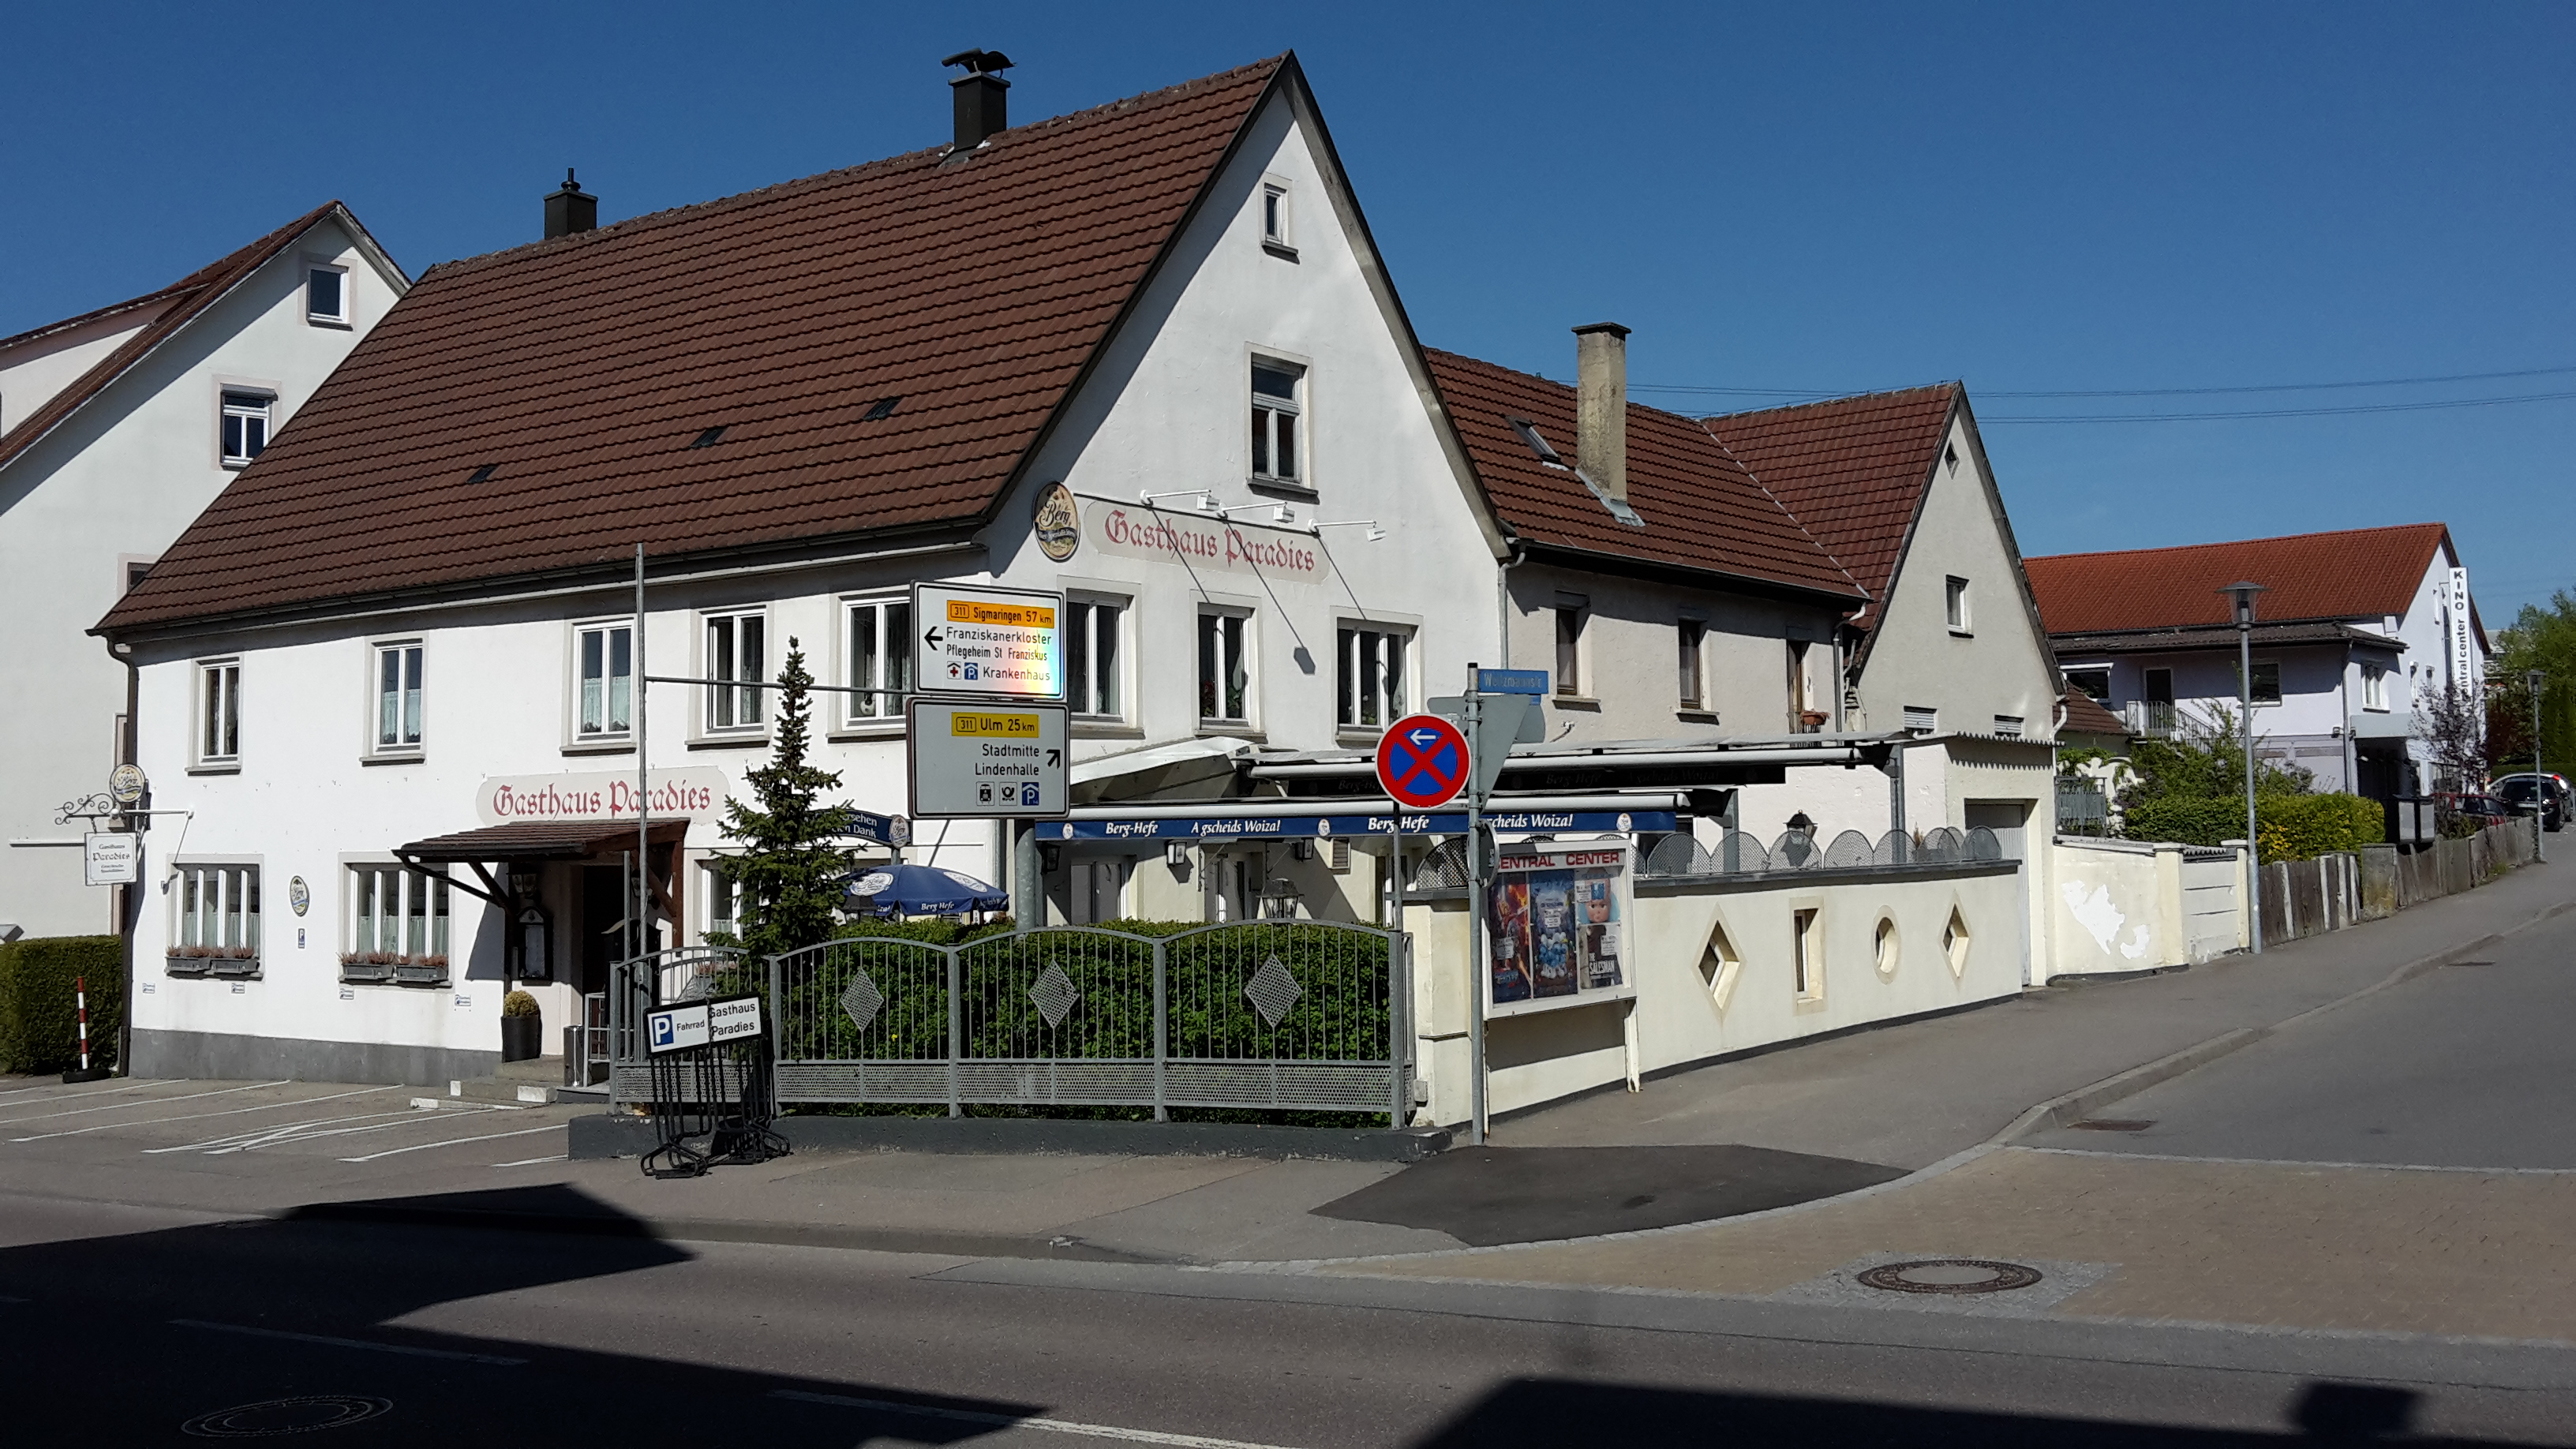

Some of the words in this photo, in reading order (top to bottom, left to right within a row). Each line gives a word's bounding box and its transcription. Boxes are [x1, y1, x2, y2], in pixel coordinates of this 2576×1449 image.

[1039, 500, 1070, 526] Berg
[1105, 510, 1218, 559] Gasthaus
[1224, 528, 1314, 571] Paradies
[2454, 571, 2464, 610] KINO
[954, 606, 965, 616] 311
[973, 607, 1021, 623] Sigmaringen
[1026, 611, 1037, 623] 57
[1040, 614, 1051, 623] km
[946, 627, 1051, 645] Franziskanerkloster
[2456, 620, 2467, 657] center
[947, 644, 990, 660] Pflegeheim
[994, 647, 1002, 658] St
[1009, 648, 1047, 661] Franziskus
[983, 666, 1050, 681] Krankenhaus
[960, 720, 972, 730] 311
[980, 717, 1002, 731] Ulm
[1008, 718, 1020, 732] 25
[1022, 722, 1035, 732] km
[982, 743, 1039, 757] Stadtmitte
[975, 762, 1039, 776] Lindenhalle
[492, 783, 601, 819] Gasthaus
[1106, 820, 1158, 837] Berg-Hefe
[1190, 821, 1199, 833] A
[1200, 819, 1241, 837] gscheids
[1245, 819, 1281, 833] Woiza!
[1531, 813, 1573, 828] Woiza!
[853, 824, 877, 838] Dank
[1498, 856, 1555, 869] ENTRAL
[1565, 852, 1619, 866] CENTER
[921, 903, 937, 912] Berg
[939, 901, 955, 911] Hefe
[710, 1003, 755, 1018] Gasthaus
[653, 1017, 670, 1044] P
[676, 1020, 705, 1032] Fahrrad
[712, 1021, 754, 1037] Paradies
